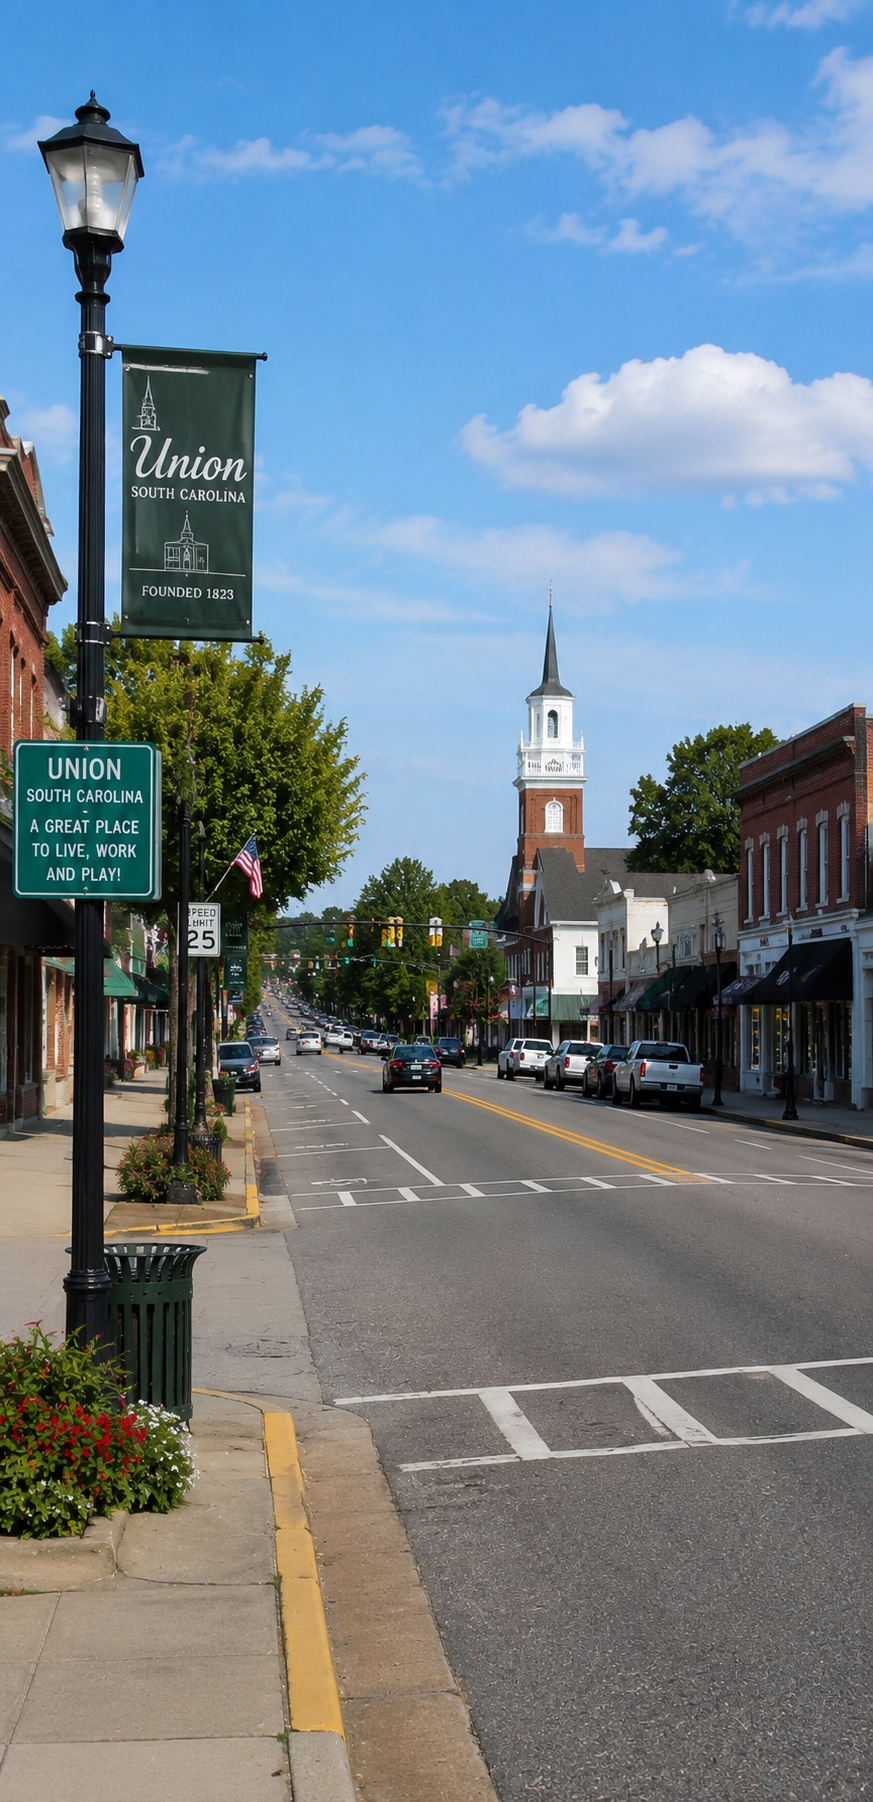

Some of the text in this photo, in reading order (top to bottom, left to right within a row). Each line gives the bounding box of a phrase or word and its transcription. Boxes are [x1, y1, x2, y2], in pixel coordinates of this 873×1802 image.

[131, 434, 248, 482] Union
[131, 486, 246, 503] SOUTH CAROLINA
[142, 585, 234, 600] FOUNDED 1823
[48, 757, 121, 780] UNION
[26, 788, 144, 804] SOUTH CAROLINA
[30, 819, 139, 835] A GREAT PLACE
[32, 843, 137, 860] TO LIVE, WORK
[46, 867, 121, 882] AND PLAY!
[188, 930, 215, 949] 25
